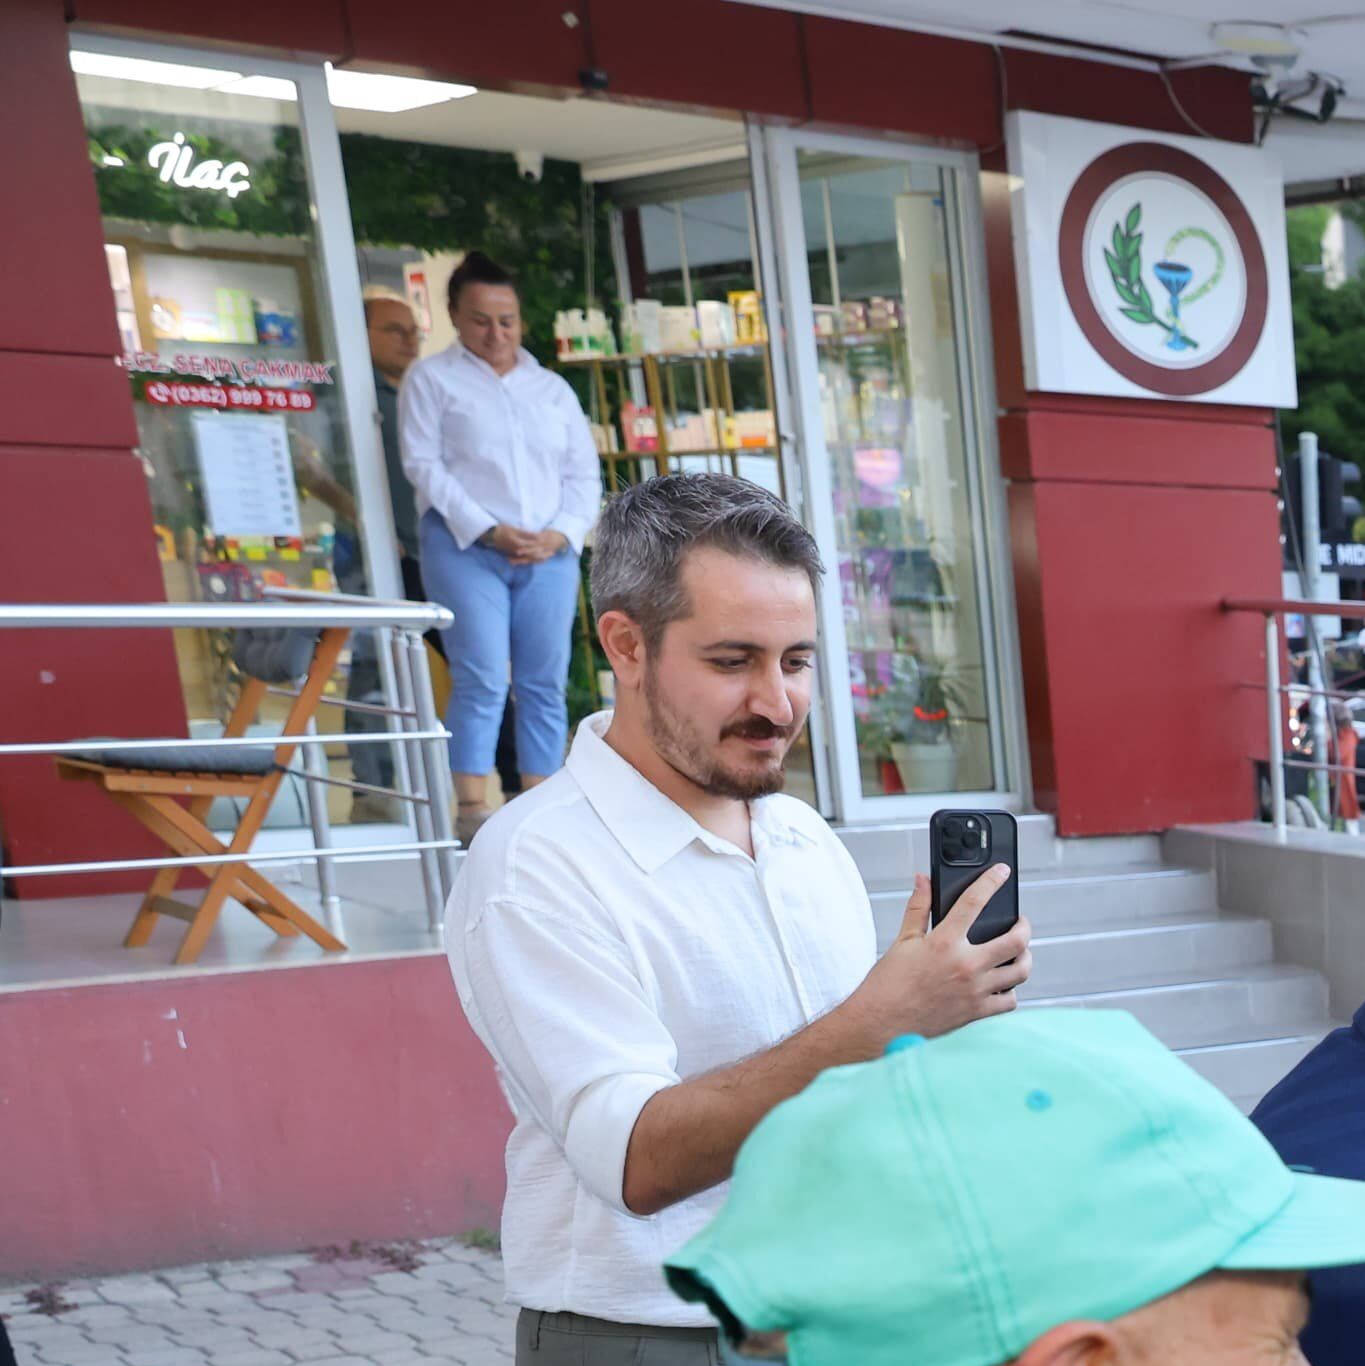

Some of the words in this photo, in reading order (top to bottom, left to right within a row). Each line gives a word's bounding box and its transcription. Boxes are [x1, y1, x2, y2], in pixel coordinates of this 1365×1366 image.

[148, 131, 250, 199] İlaç
[174, 354, 236, 379] SENA
[237, 358, 334, 385] ÇAKMAK
